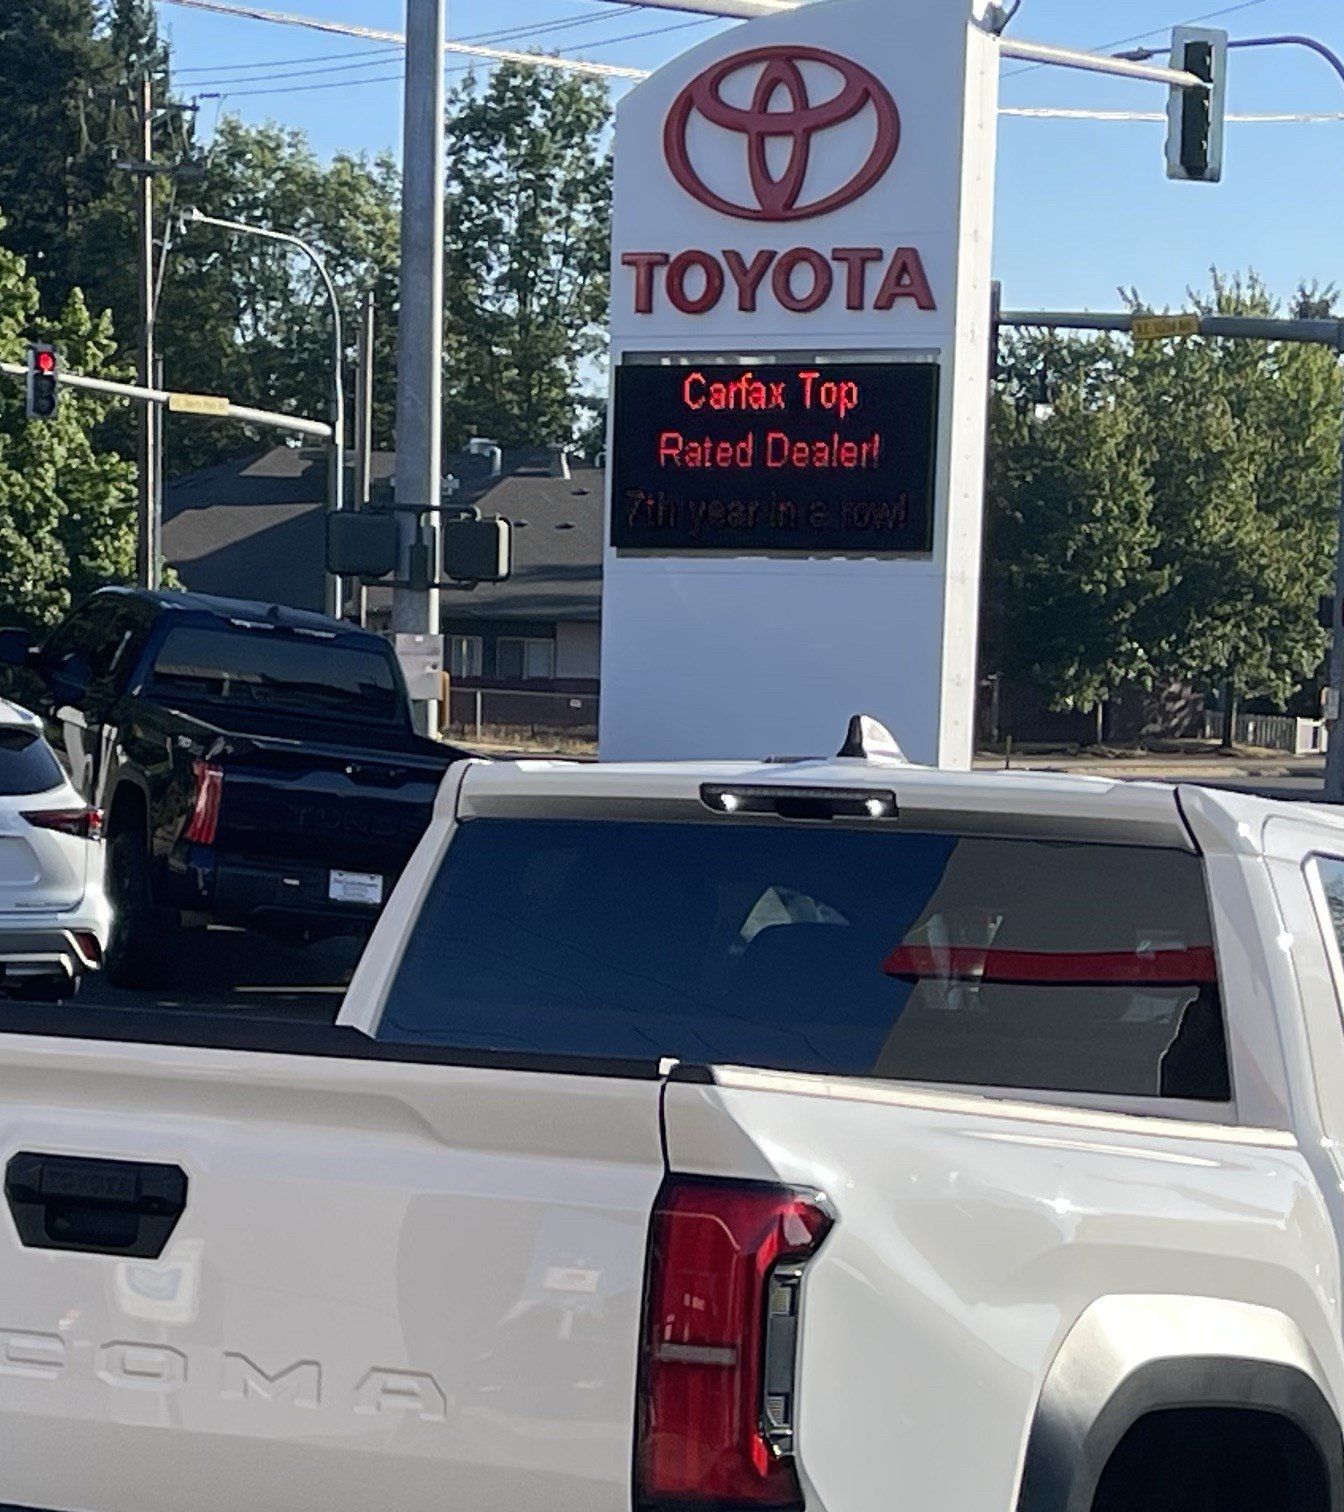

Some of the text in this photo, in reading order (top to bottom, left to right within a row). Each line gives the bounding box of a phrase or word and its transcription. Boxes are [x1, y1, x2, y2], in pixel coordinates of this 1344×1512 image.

[621, 246, 937, 315] TOYOTA
[683, 371, 859, 418] Carfax Top
[658, 431, 881, 469] Rated Dealer!
[688, 499, 760, 537] year
